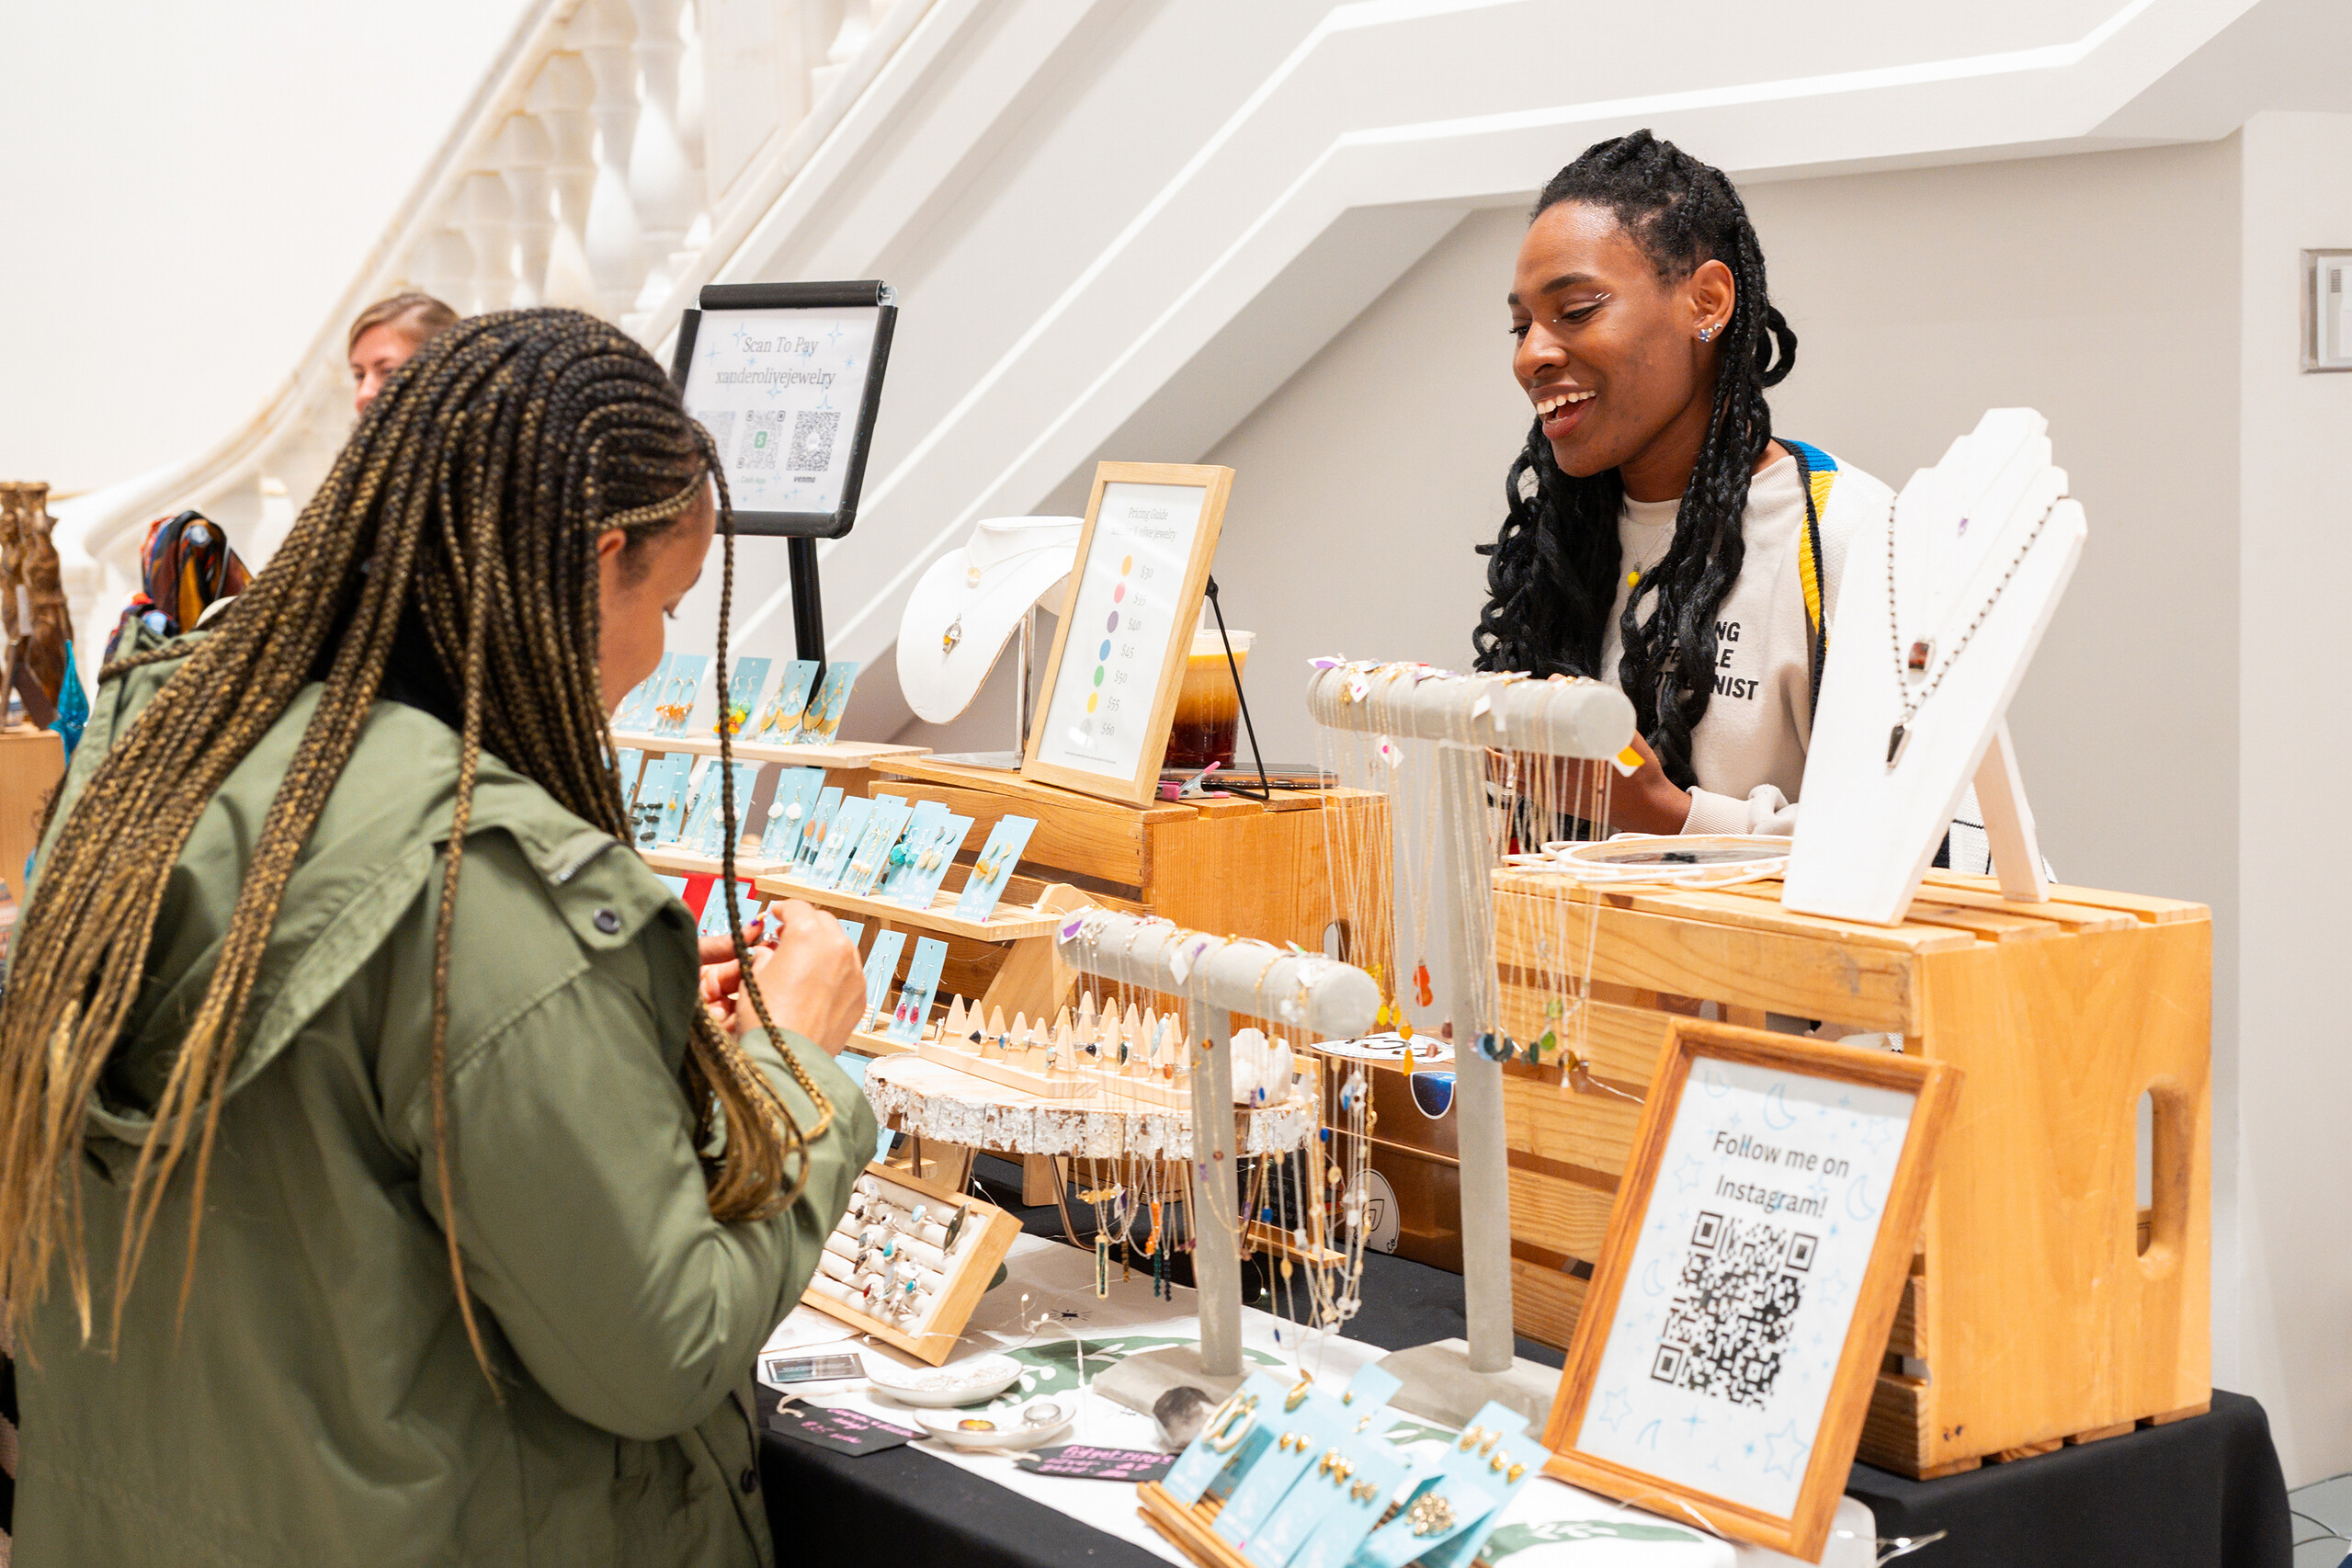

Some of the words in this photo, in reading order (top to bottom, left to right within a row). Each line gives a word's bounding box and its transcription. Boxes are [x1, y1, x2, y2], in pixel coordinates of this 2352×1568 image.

[743, 336, 772, 353] Scan
[776, 337, 792, 353] To
[794, 337, 819, 357] Pay
[714, 368, 836, 389] xanderolivejewelry
[793, 475, 816, 483] venmo
[1128, 507, 1150, 522] Pricing
[1150, 508, 1169, 520] Guide
[1153, 527, 1177, 542] jewelry
[1140, 564, 1154, 579] $30
[1127, 617, 1142, 632] $40
[1119, 643, 1134, 659] $45
[1113, 670, 1128, 685] $50
[1106, 695, 1120, 711] $55
[1100, 722, 1115, 737] $60
[1712, 1130, 1782, 1165] Follow
[1784, 1150, 1819, 1173] me
[1823, 1156, 1850, 1179] on
[1715, 1175, 1828, 1219] Instagram!
